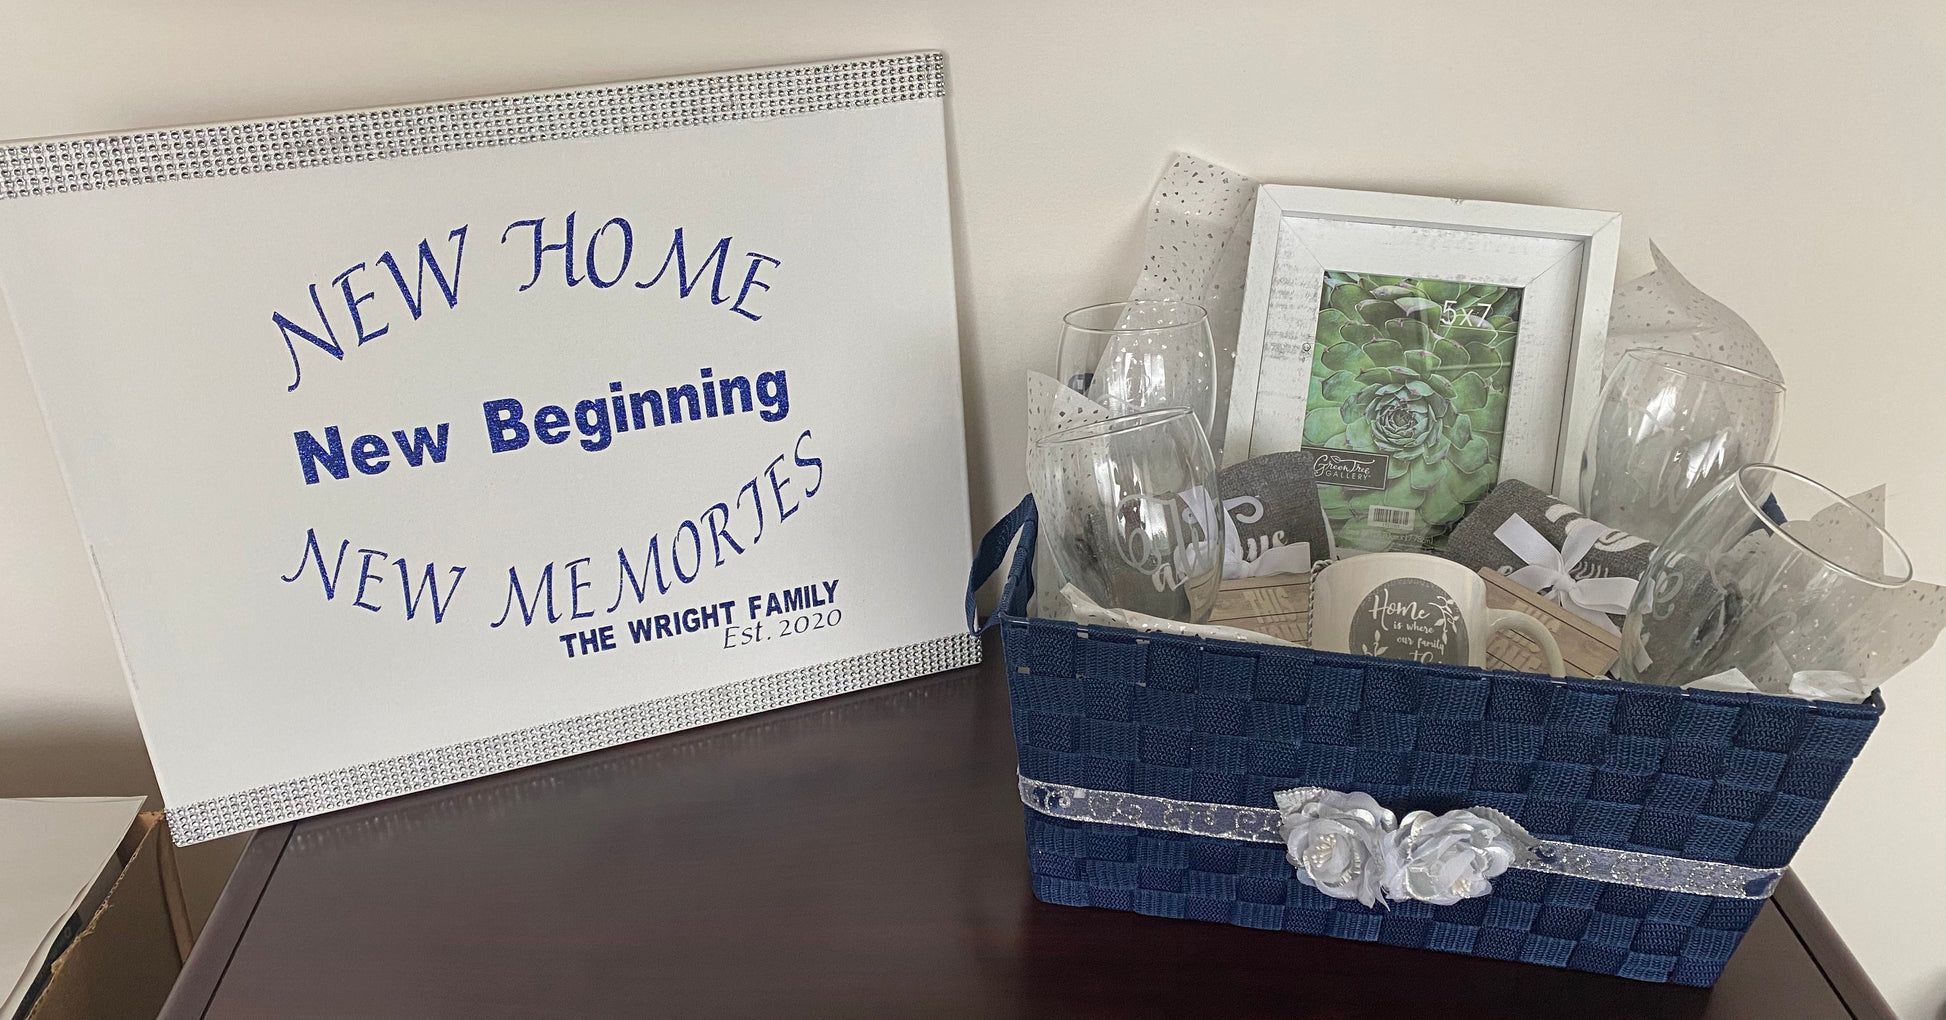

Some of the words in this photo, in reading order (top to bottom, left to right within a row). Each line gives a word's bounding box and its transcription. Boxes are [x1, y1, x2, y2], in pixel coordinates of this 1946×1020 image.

[272, 224, 468, 393] NEW
[501, 211, 782, 322] HOME
[1440, 299, 1493, 328] 5x7
[293, 422, 450, 486] New
[483, 367, 790, 454] Beginning
[281, 529, 466, 625] NEW
[490, 429, 824, 629] MEMORIES
[559, 625, 617, 658] THE
[628, 600, 737, 645] WRIGHT
[748, 580, 839, 620] FAMILY
[722, 621, 771, 650] Est.
[779, 608, 842, 638] 2020
[1368, 588, 1431, 631] Home
[1393, 621, 1403, 630] is
[1406, 621, 1435, 634] where
[1397, 637, 1415, 645] our
[1417, 637, 1445, 656] family
